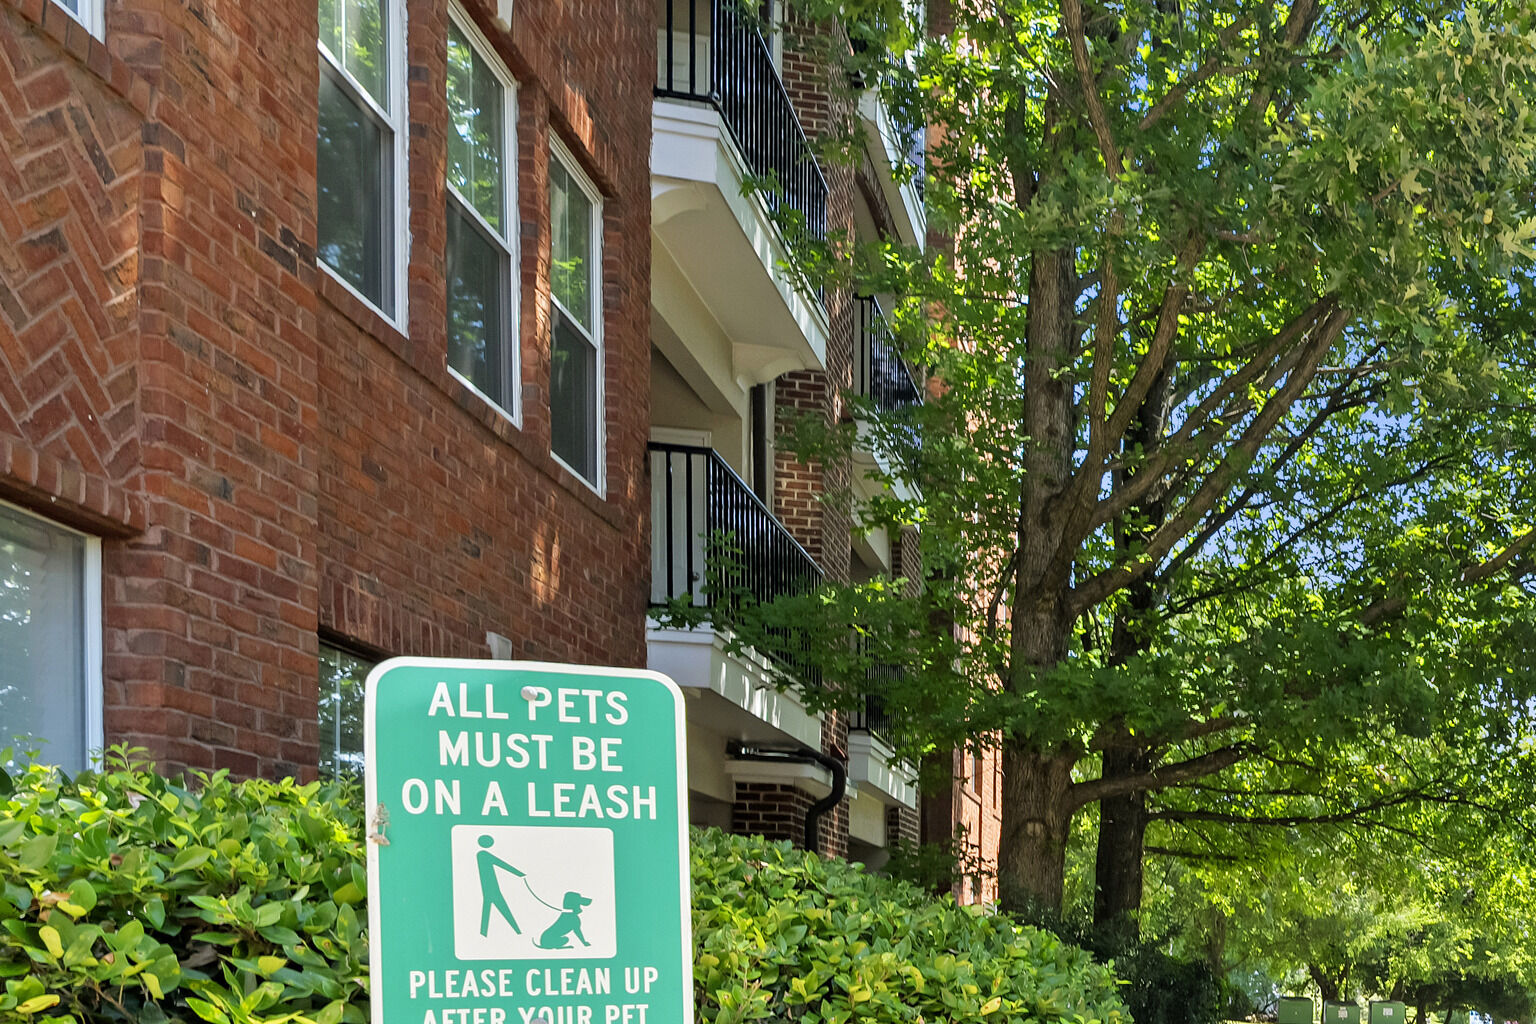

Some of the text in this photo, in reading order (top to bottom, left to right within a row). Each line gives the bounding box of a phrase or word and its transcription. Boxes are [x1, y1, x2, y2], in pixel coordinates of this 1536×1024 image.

[427, 682, 629, 725] ALL PETS
[438, 730, 623, 772] MUST BE
[401, 778, 657, 820] ON A LEASH
[410, 967, 658, 999] PLEASE CLEAN UP
